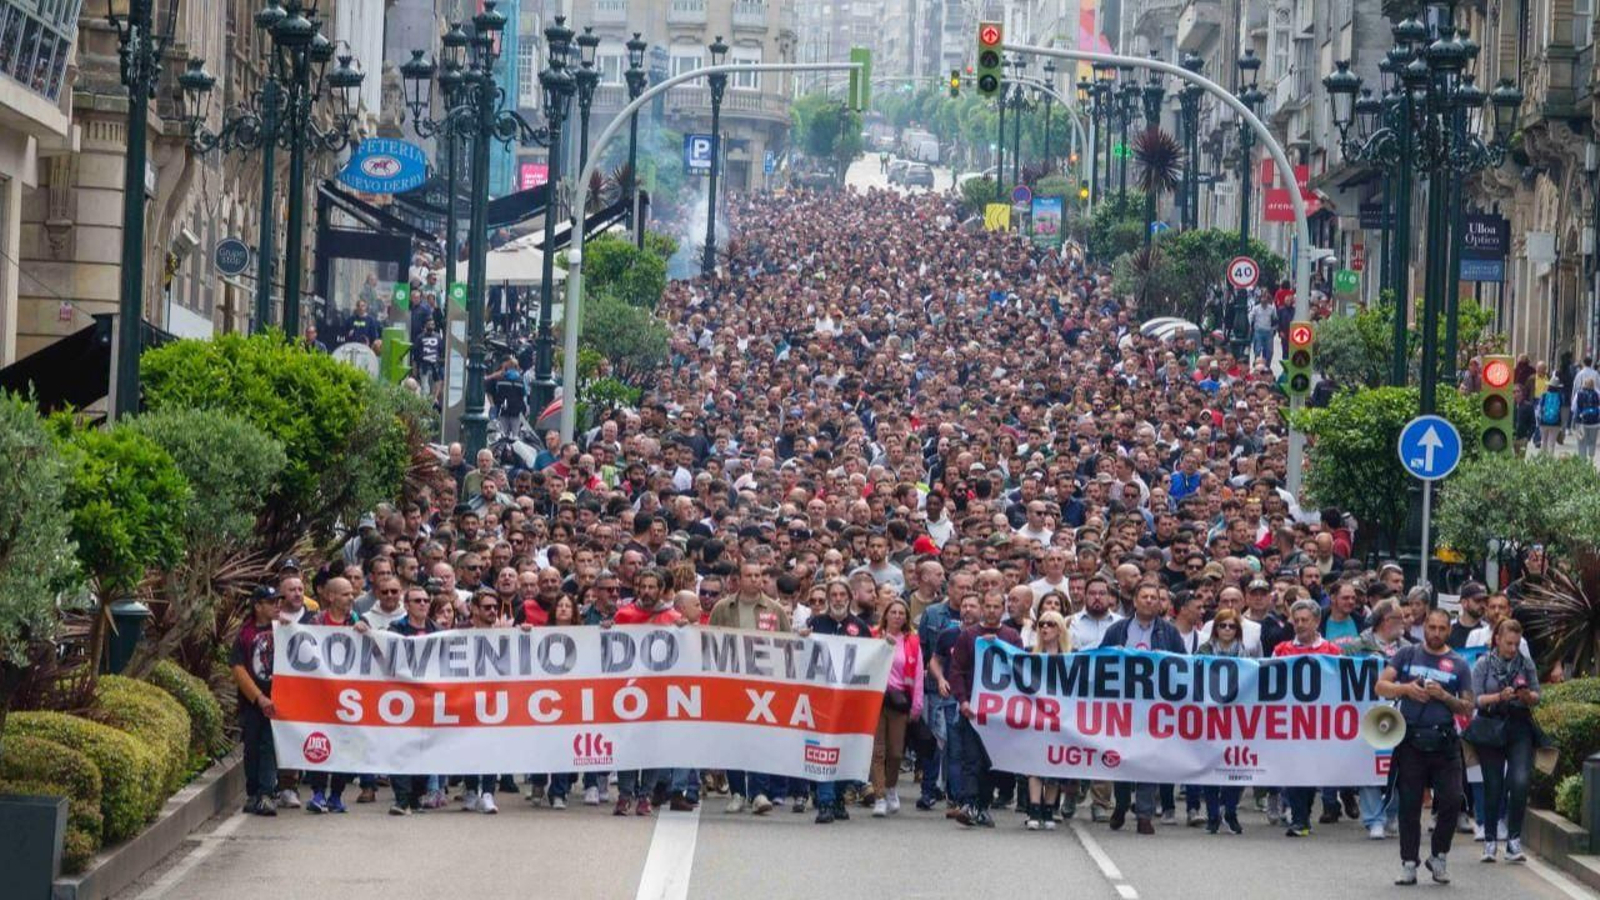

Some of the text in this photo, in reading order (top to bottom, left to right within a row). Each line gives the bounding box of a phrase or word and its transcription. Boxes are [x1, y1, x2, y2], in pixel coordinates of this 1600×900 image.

[356, 139, 424, 163] FETERIA
[694, 139, 710, 158] P
[1469, 222, 1496, 234] Ulloa
[1234, 267, 1252, 278] 40
[286, 630, 871, 685] CONVENIO DO METAL
[981, 645, 1387, 703] COMERCIO DO M
[336, 679, 816, 729] SOLUCIÓN XA
[977, 692, 1359, 740] POR UN CONVENIO
[573, 732, 613, 756] CIG
[1048, 745, 1097, 766] UGT
[1224, 745, 1258, 766] CIG
